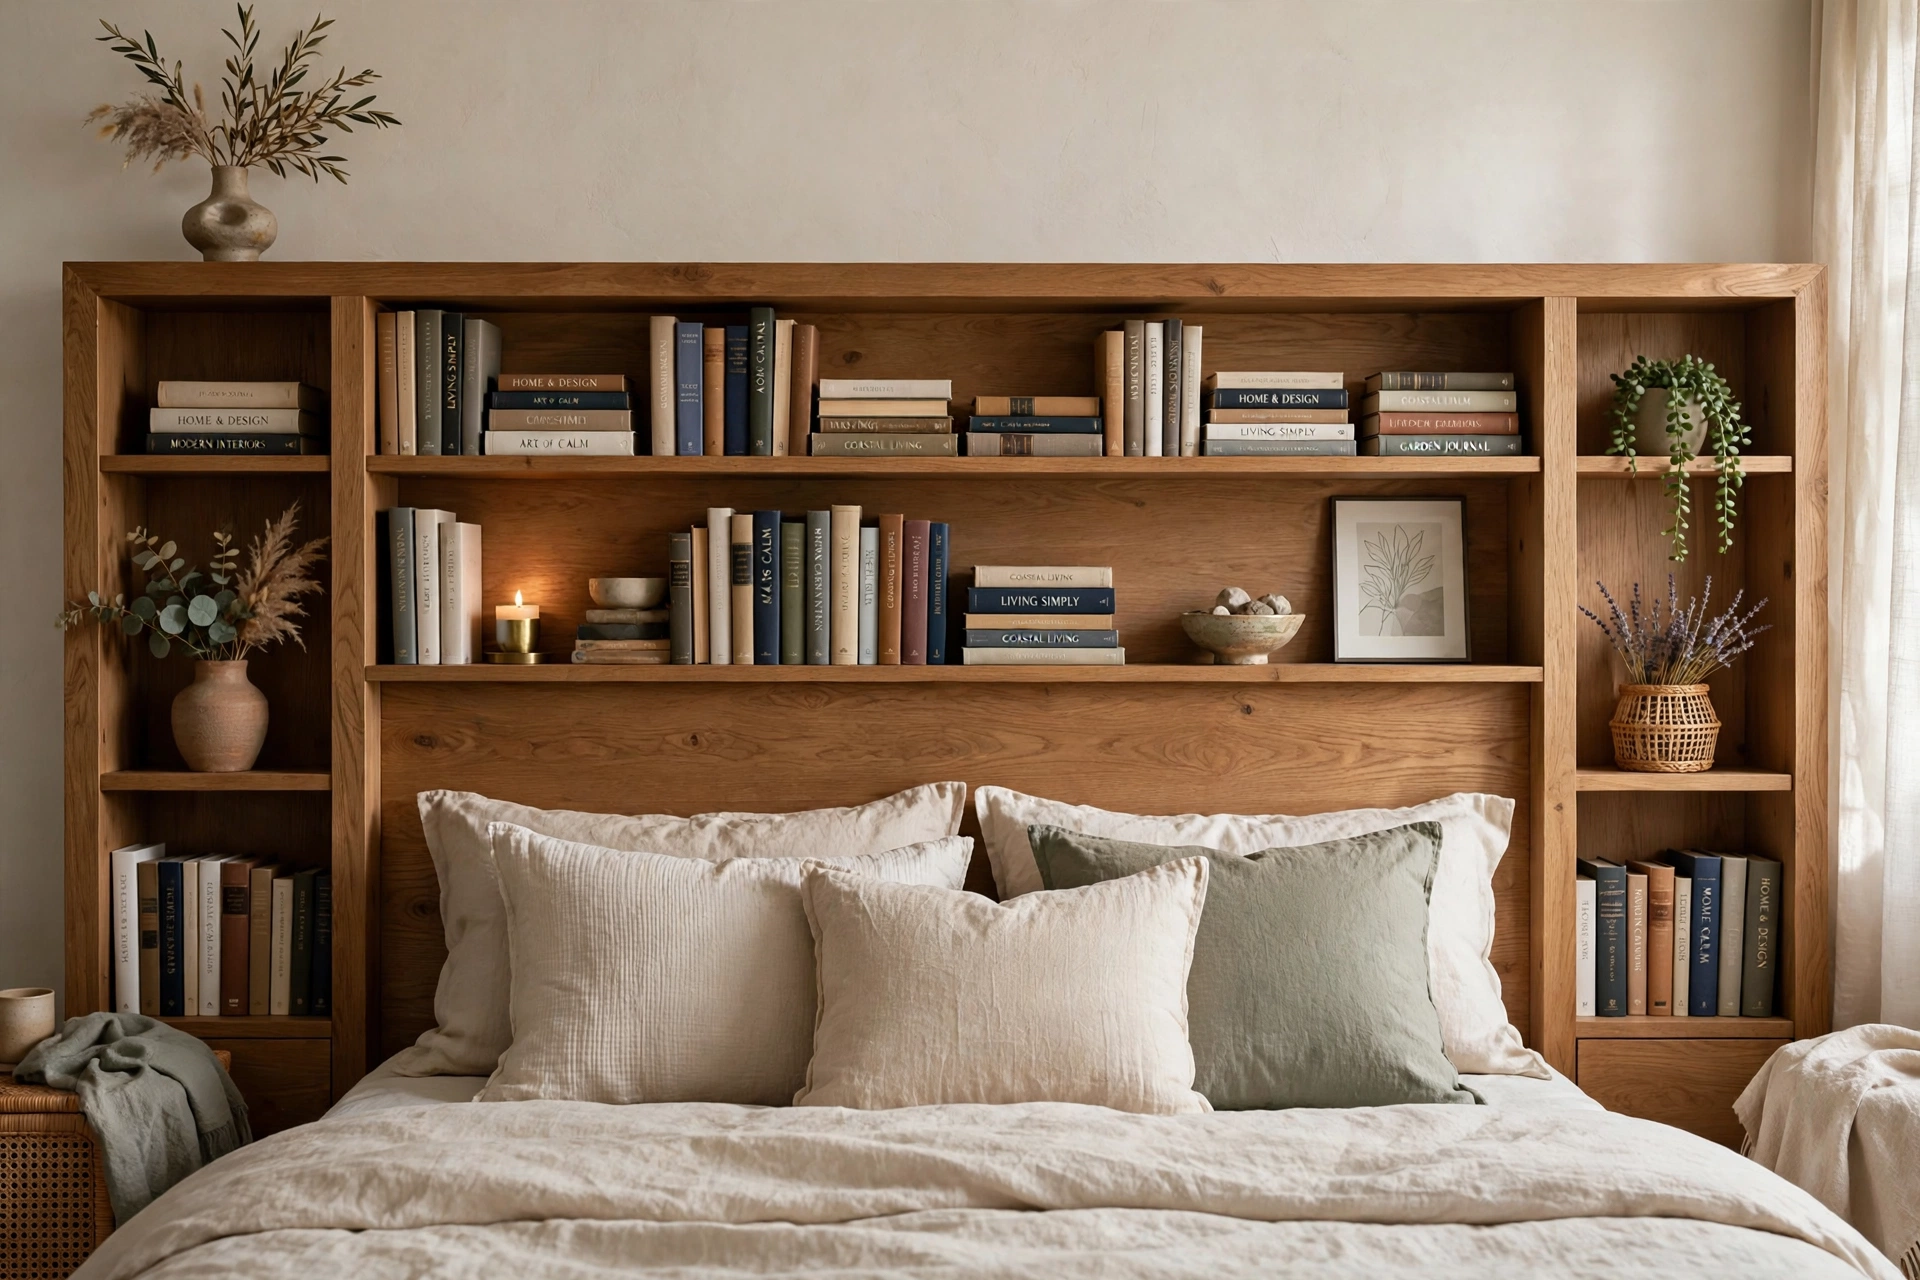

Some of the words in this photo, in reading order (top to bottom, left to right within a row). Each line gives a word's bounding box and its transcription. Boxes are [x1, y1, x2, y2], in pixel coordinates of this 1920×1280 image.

[512, 378, 544, 387] HOME
[547, 378, 555, 387] &
[559, 378, 598, 387] DESIGN
[1239, 394, 1269, 404] HOME
[1271, 394, 1279, 404] &
[1282, 394, 1319, 404] DESIGN
[177, 416, 212, 426] HOME
[215, 416, 224, 426] &
[227, 416, 269, 426] DESIGN
[1240, 427, 1276, 437] LIVING
[1279, 427, 1316, 437] SIMPLY
[519, 439, 538, 449] ART
[558, 439, 589, 449] CALM
[1400, 441, 1441, 452] GARDEN
[1444, 440, 1491, 453] JOURNAL
[761, 527, 773, 564] CALM
[1001, 595, 1038, 607] LIVING
[1041, 595, 1080, 607] SIMPLY
[1759, 877, 1771, 913] HOME
[1759, 914, 1769, 923] &
[1756, 927, 1769, 969] DESIGN
